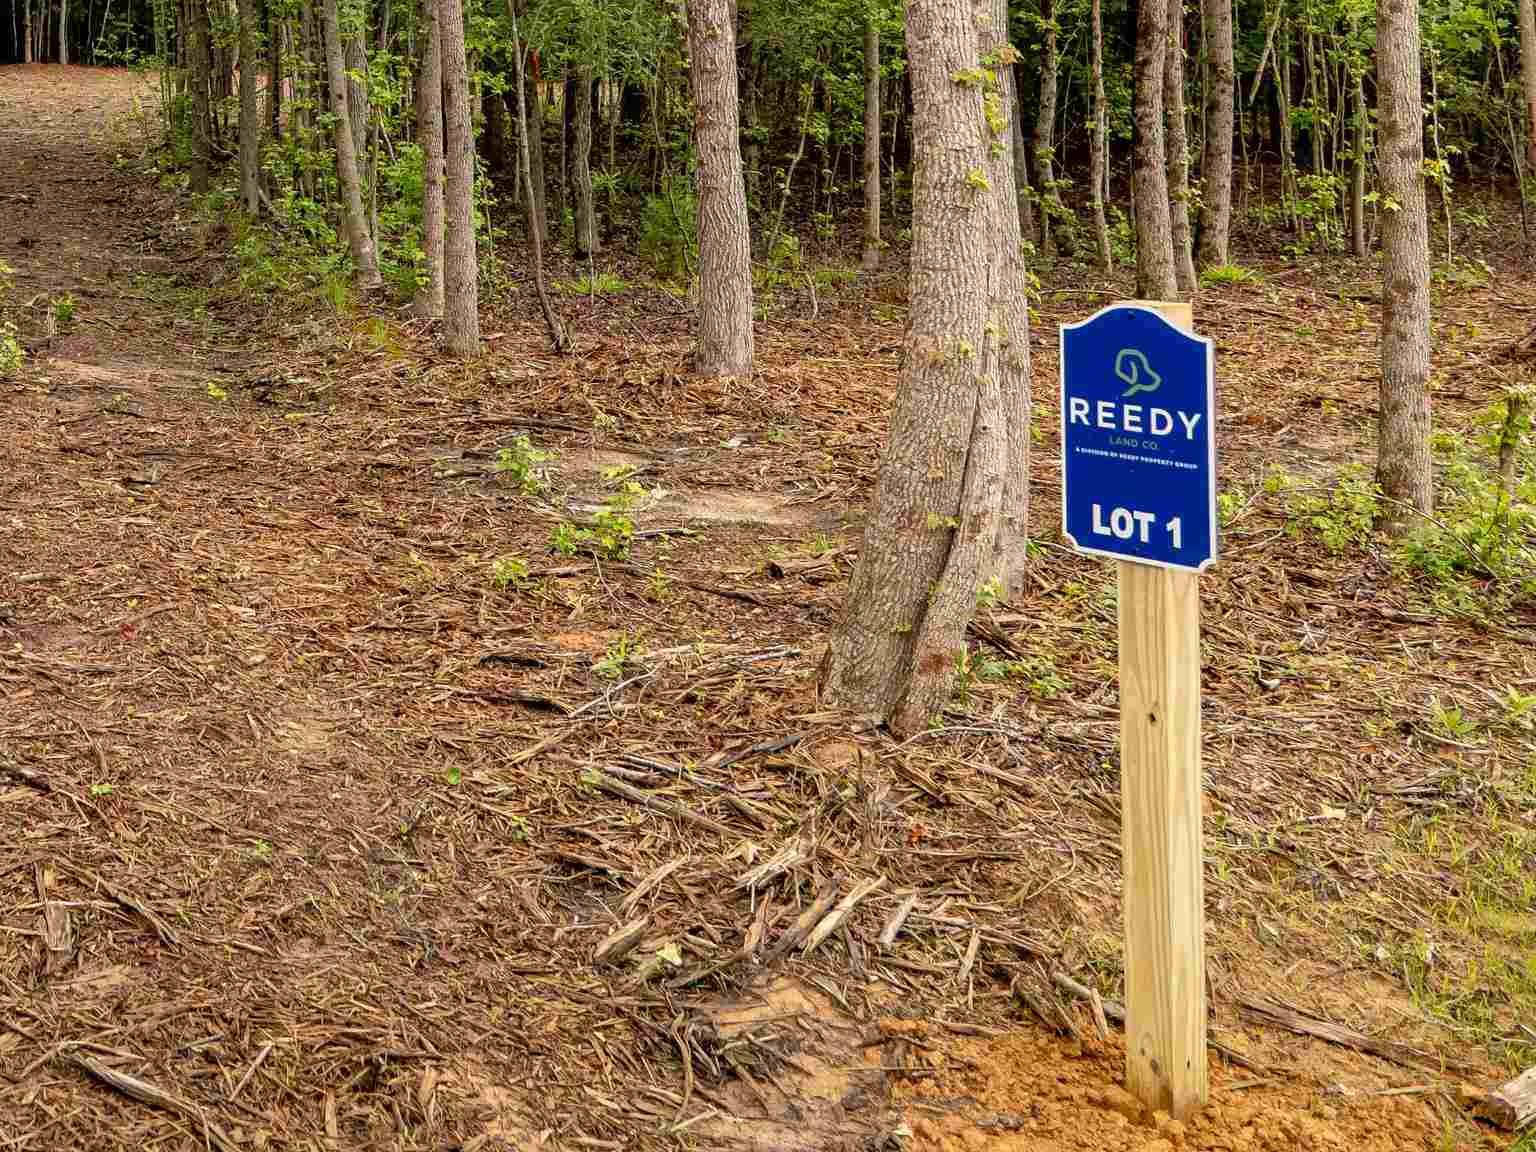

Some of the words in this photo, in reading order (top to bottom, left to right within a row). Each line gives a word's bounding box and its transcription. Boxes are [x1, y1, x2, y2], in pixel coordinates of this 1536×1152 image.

[1069, 396, 1201, 440] REEDY
[1109, 436, 1138, 448] LAND
[1091, 503, 1156, 543] LOT
[1165, 515, 1183, 549] 1
